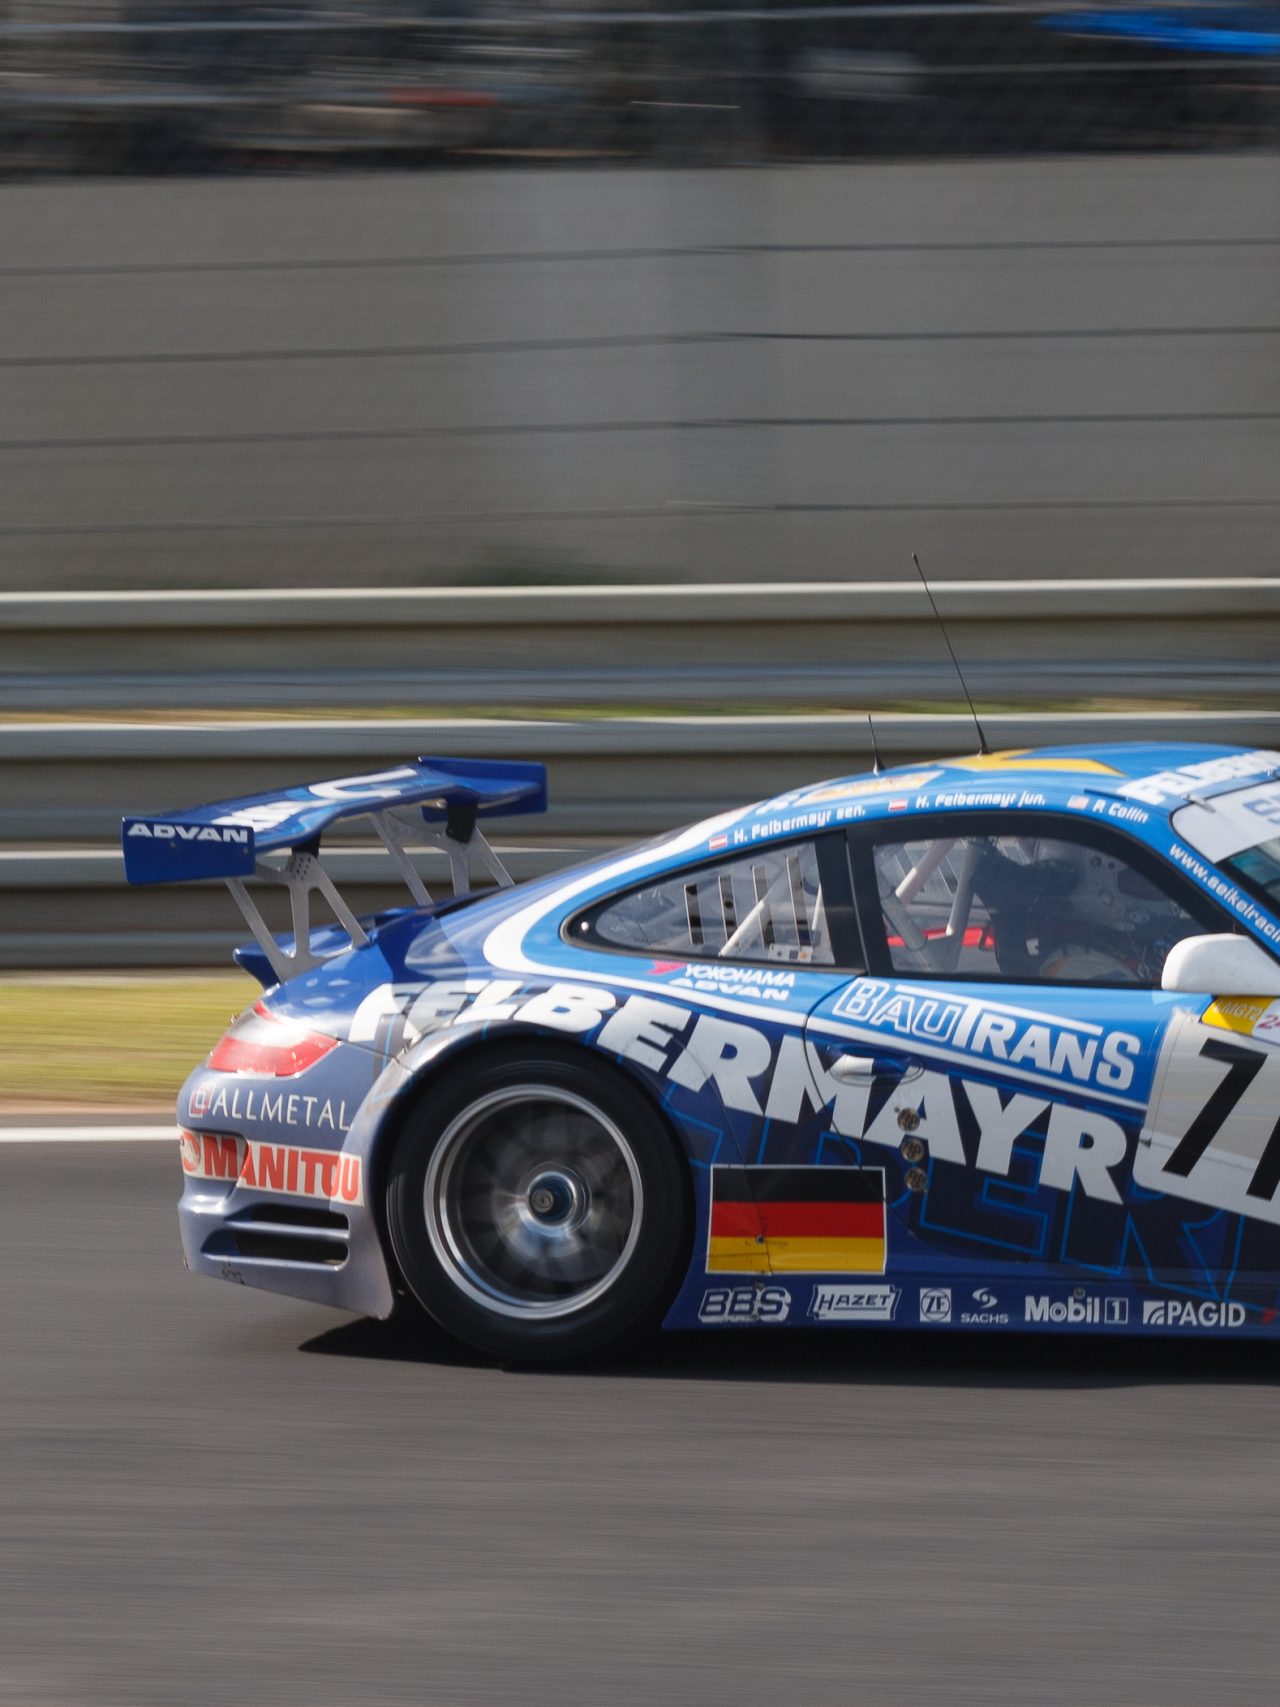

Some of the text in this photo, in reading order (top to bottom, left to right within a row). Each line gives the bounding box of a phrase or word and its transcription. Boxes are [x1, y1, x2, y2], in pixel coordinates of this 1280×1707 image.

[915, 790, 1046, 809] H. Felbermayr jun.
[127, 823, 248, 843] ADVAN
[734, 805, 866, 845] H. Felbermayr sen.
[685, 963, 796, 988] YOKOHAMA
[668, 977, 790, 1002] ADVAN
[833, 977, 1140, 1091] BAUTRANS
[349, 980, 1124, 1205] FELBERMAYR
[212, 1087, 352, 1133] ALLMETAL
[203, 1134, 361, 1202] MANITOU
[698, 1286, 792, 1323] BBS
[817, 1293, 891, 1311] HAZET
[1024, 1295, 1100, 1323] Mobil
[1167, 1301, 1246, 1328] PAGID
[960, 1312, 1009, 1325] SACHS
